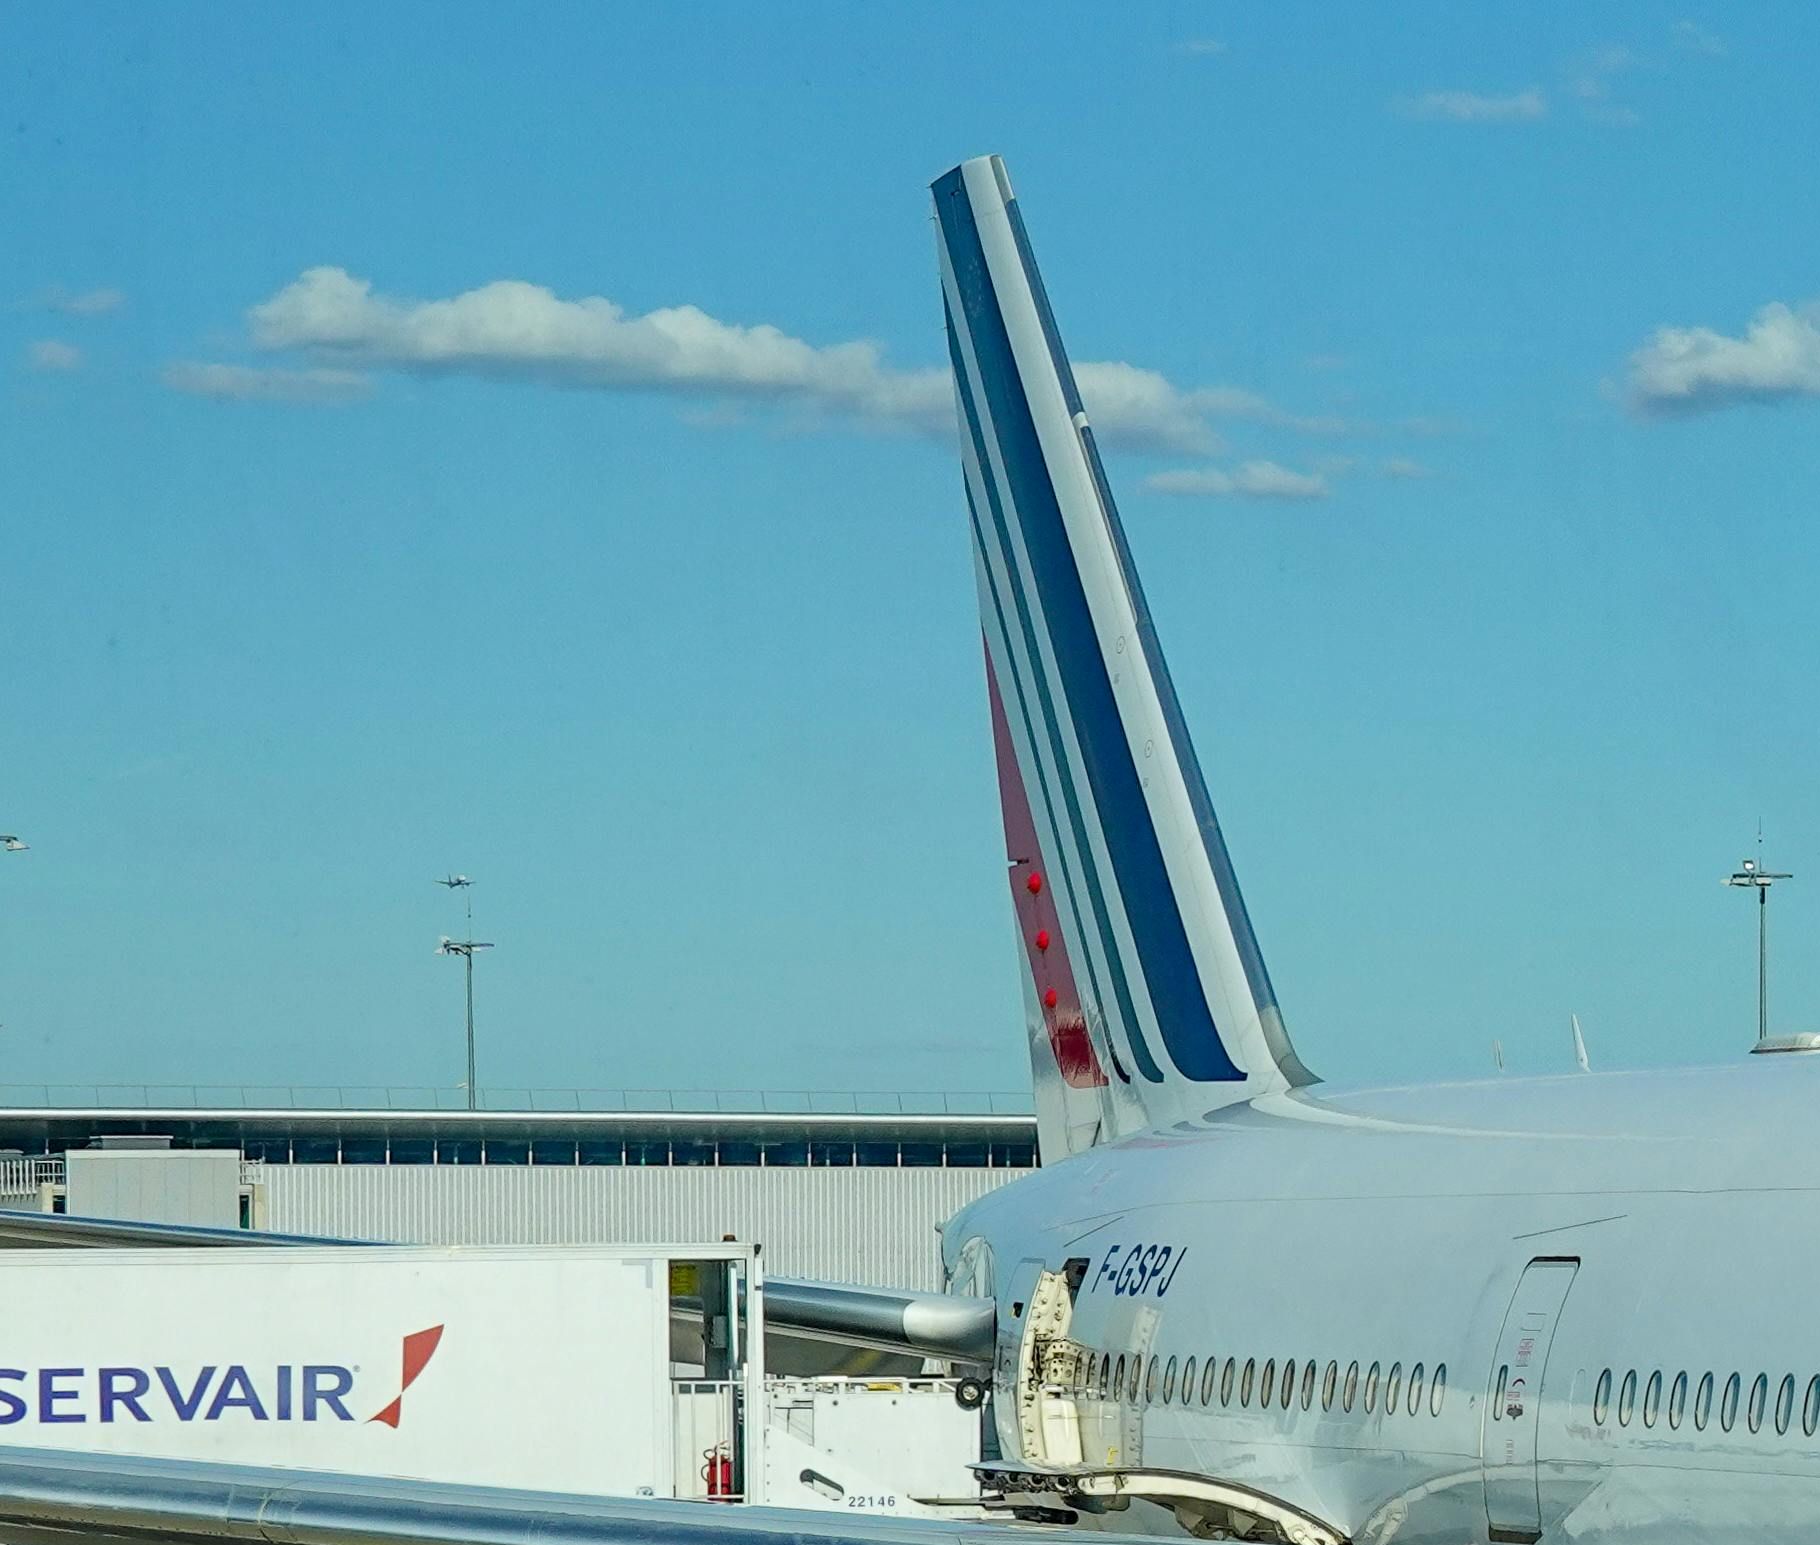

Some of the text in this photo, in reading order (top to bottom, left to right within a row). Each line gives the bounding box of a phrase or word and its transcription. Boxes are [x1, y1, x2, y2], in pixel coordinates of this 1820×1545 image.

[1091, 1243, 1188, 1298] F-GSPJ
[0, 1364, 356, 1425] SERVAIR
[848, 1496, 896, 1508] 22146
